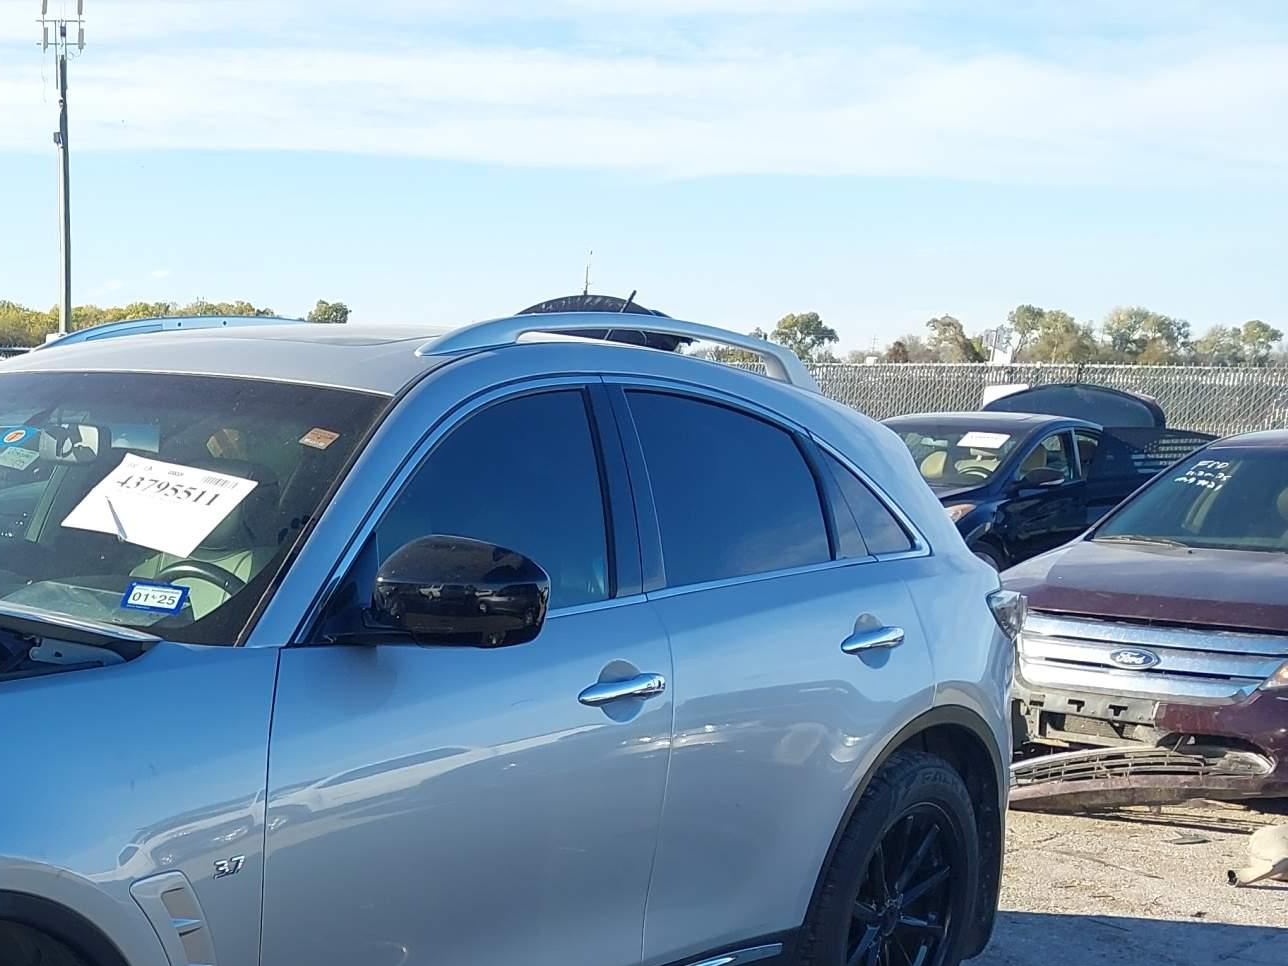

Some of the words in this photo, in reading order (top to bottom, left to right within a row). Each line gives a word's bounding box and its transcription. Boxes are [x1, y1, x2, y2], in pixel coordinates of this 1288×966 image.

[116, 474, 220, 506] 43795511
[157, 594, 176, 606] 25
[1116, 651, 1146, 665] Ford
